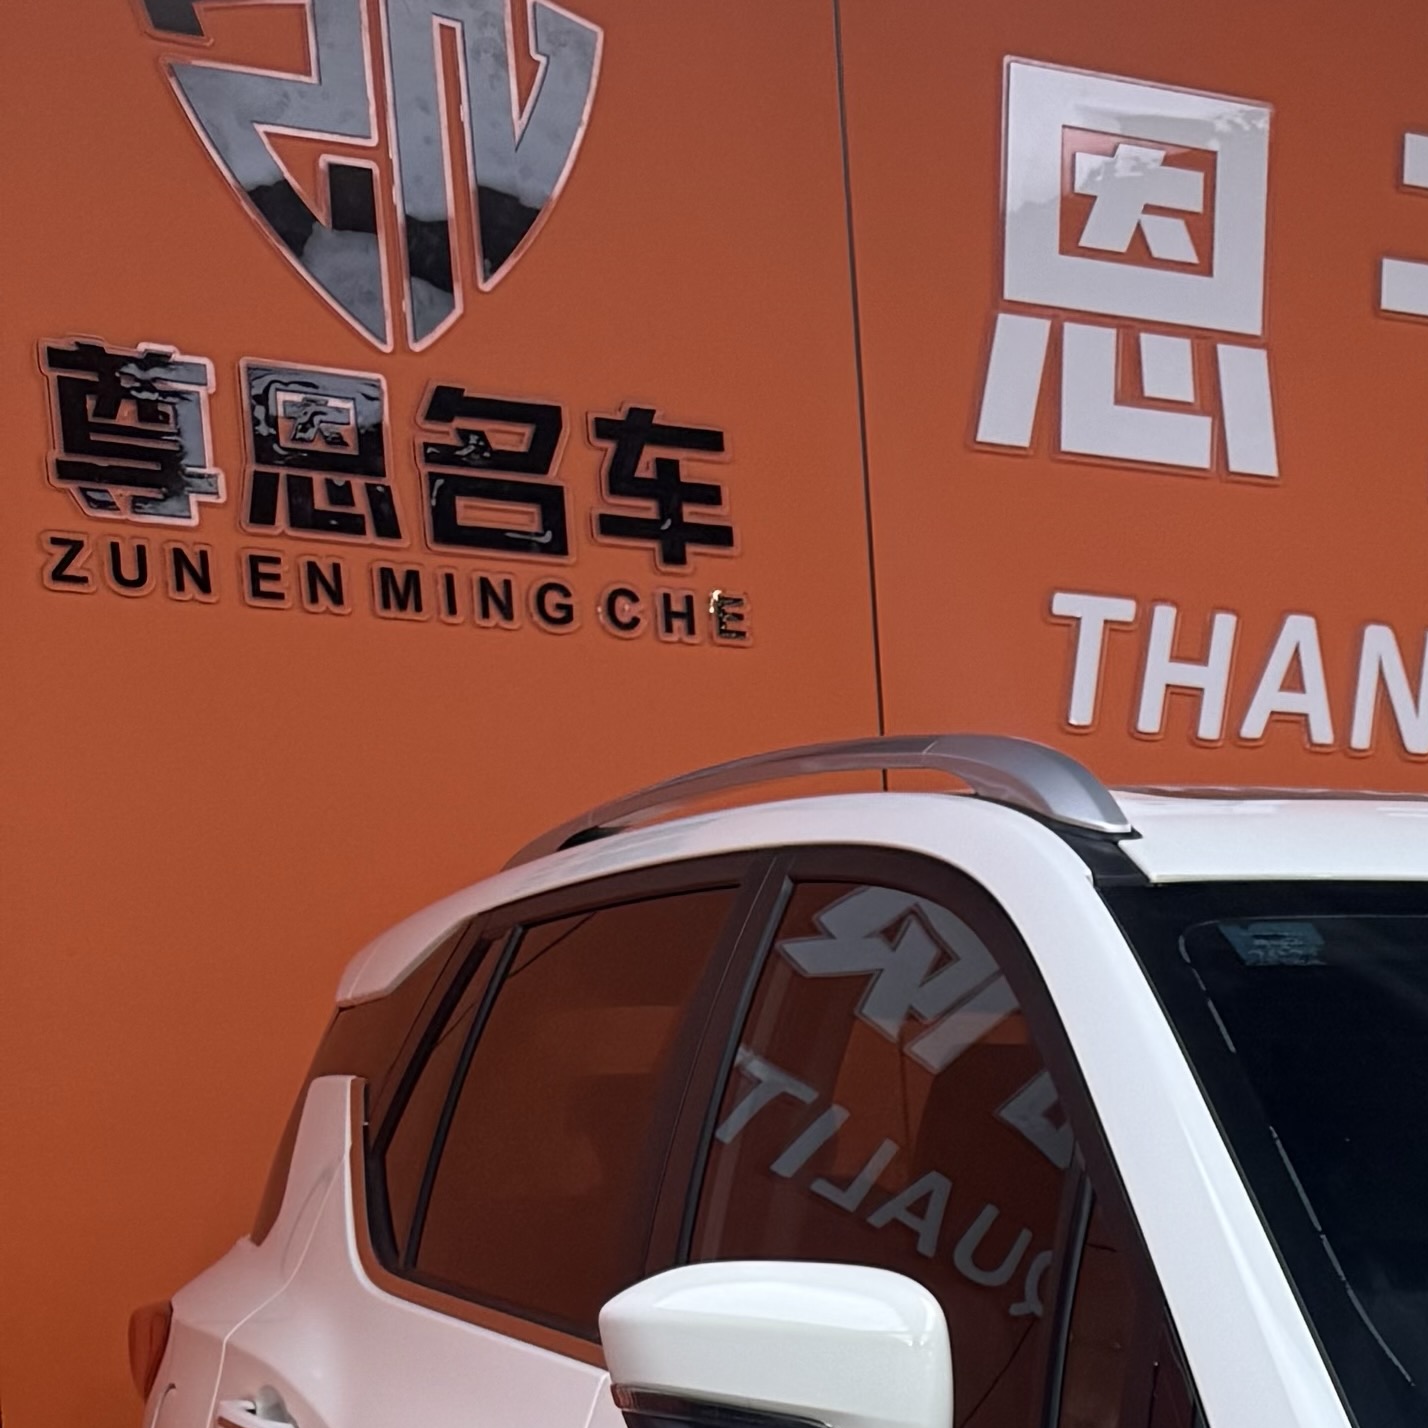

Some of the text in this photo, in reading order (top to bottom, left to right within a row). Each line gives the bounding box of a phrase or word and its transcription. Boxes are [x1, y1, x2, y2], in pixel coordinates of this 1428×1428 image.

[40, 340, 738, 566] 尊恩名车
[50, 536, 748, 641] ZUN EN MING CHE
